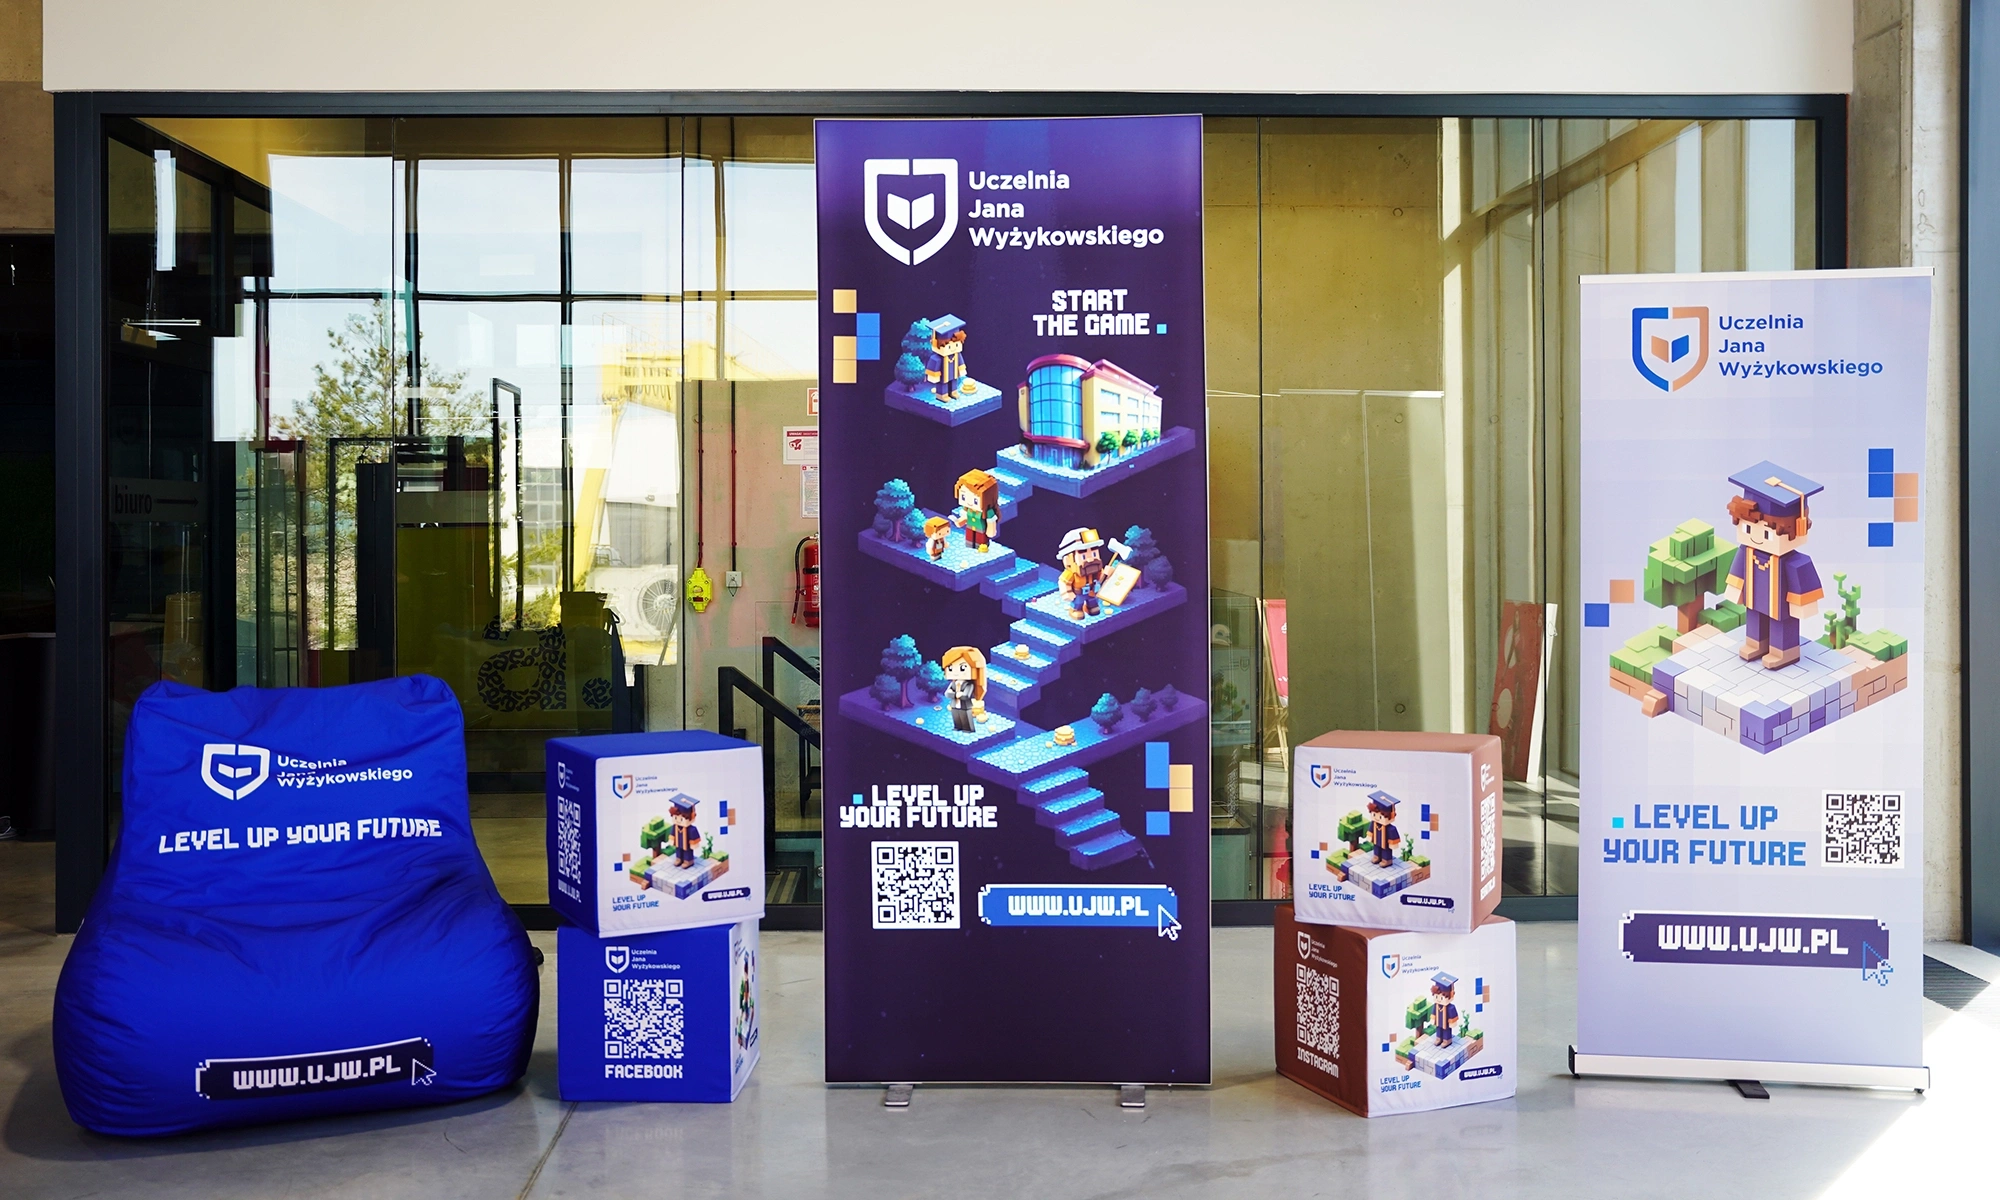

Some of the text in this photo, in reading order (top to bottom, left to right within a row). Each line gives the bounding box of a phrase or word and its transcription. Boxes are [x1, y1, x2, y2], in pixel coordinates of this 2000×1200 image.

[968, 170, 1070, 190] Uczelnia
[968, 199, 1025, 218] Jana
[968, 225, 1164, 250] Wyżykowskiego
[1052, 289, 1128, 311] START
[1033, 313, 1150, 336] THE GAME
[1718, 314, 1804, 330] Uczelnia
[1718, 339, 1765, 353] Jana
[1718, 359, 1883, 379] Wyżykowskiego
[114, 485, 152, 515] biuro
[277, 755, 347, 770] Uczelnia
[276, 767, 413, 788] Wyżykowskiego
[871, 784, 985, 807] LEVEL UP
[840, 805, 998, 828] YOUR FUTURE
[1634, 804, 1778, 830] LEVEL UP
[158, 817, 443, 853] LEVEL UP YOUR FUTURE
[1603, 838, 1806, 866] YOUR FUTURE
[1308, 883, 1331, 892] LEVEL
[1308, 891, 1355, 901] YOUR FUTURE
[612, 894, 646, 904] LEVEL UP
[632, 900, 659, 909] FUTURE
[1008, 895, 1150, 916] WWW.UJW.PL
[1658, 924, 1848, 955] WWW.UJW.PL
[233, 1055, 401, 1090] WWW.UJW.PL
[605, 1064, 683, 1079] FACEBOOK
[1297, 1046, 1339, 1078] INSTAGRAM
[1380, 1076, 1400, 1085] LEVEL
[1381, 1080, 1421, 1093] YOUR FUTURE
